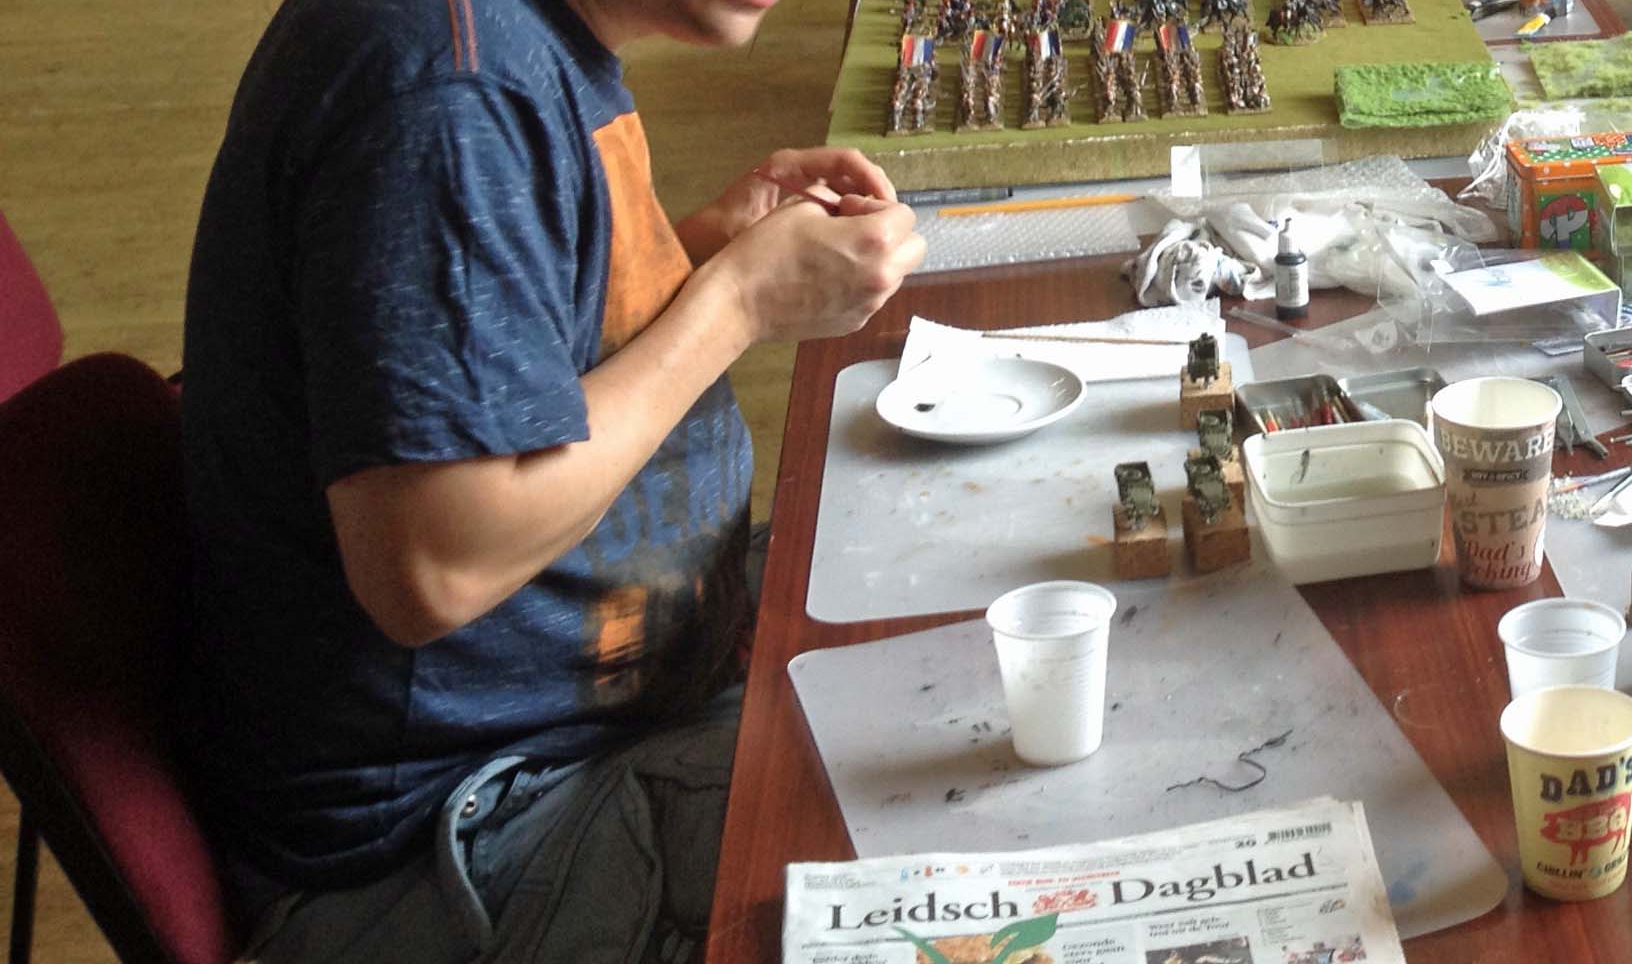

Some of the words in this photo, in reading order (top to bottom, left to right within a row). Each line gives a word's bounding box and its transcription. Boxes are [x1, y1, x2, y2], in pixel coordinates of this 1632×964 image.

[1440, 426, 1555, 463] BEWARE
[826, 890, 1021, 932] Leidsch
[1110, 852, 1319, 905] Dagblad
